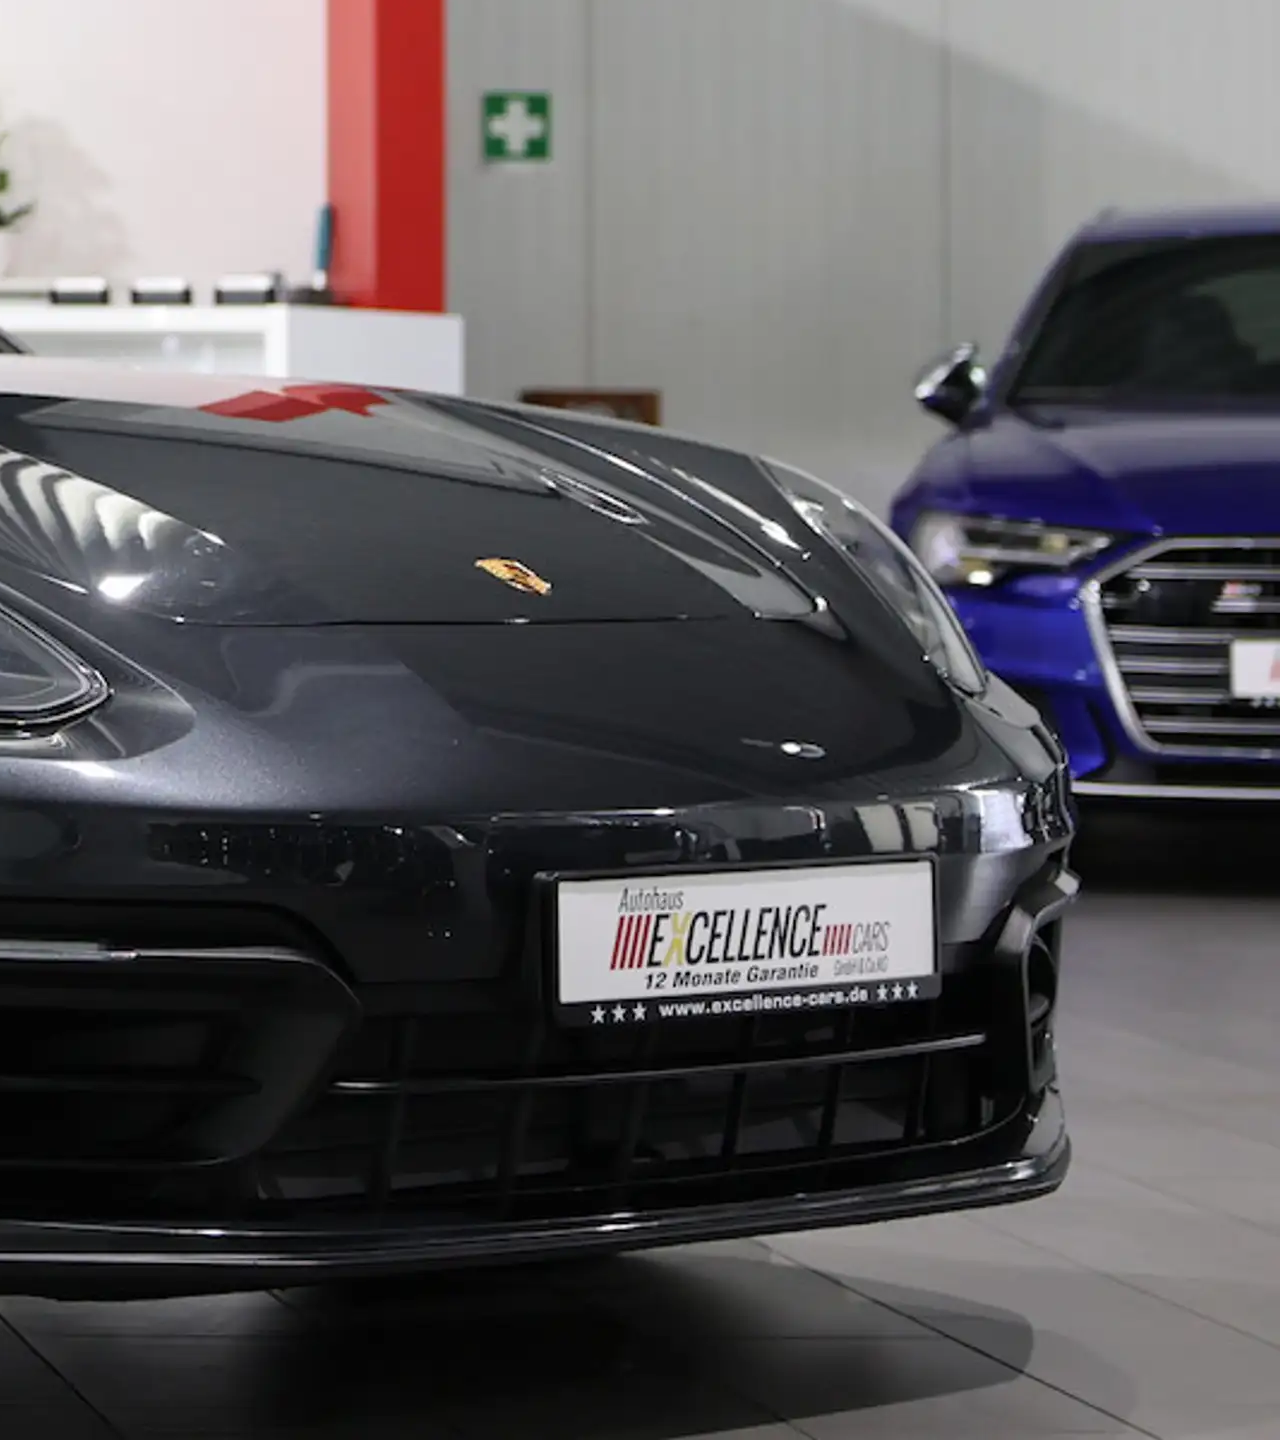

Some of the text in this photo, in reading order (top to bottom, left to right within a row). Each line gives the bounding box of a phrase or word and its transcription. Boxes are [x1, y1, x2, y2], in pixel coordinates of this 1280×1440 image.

[618, 887, 684, 913] Autohaus
[646, 904, 826, 968] EXCELLENCE
[851, 921, 891, 954] CARS
[644, 972, 667, 990] 12
[672, 967, 741, 989] Monate
[746, 961, 819, 984] Garantie
[658, 986, 869, 1019] www.excellence-cars.de
